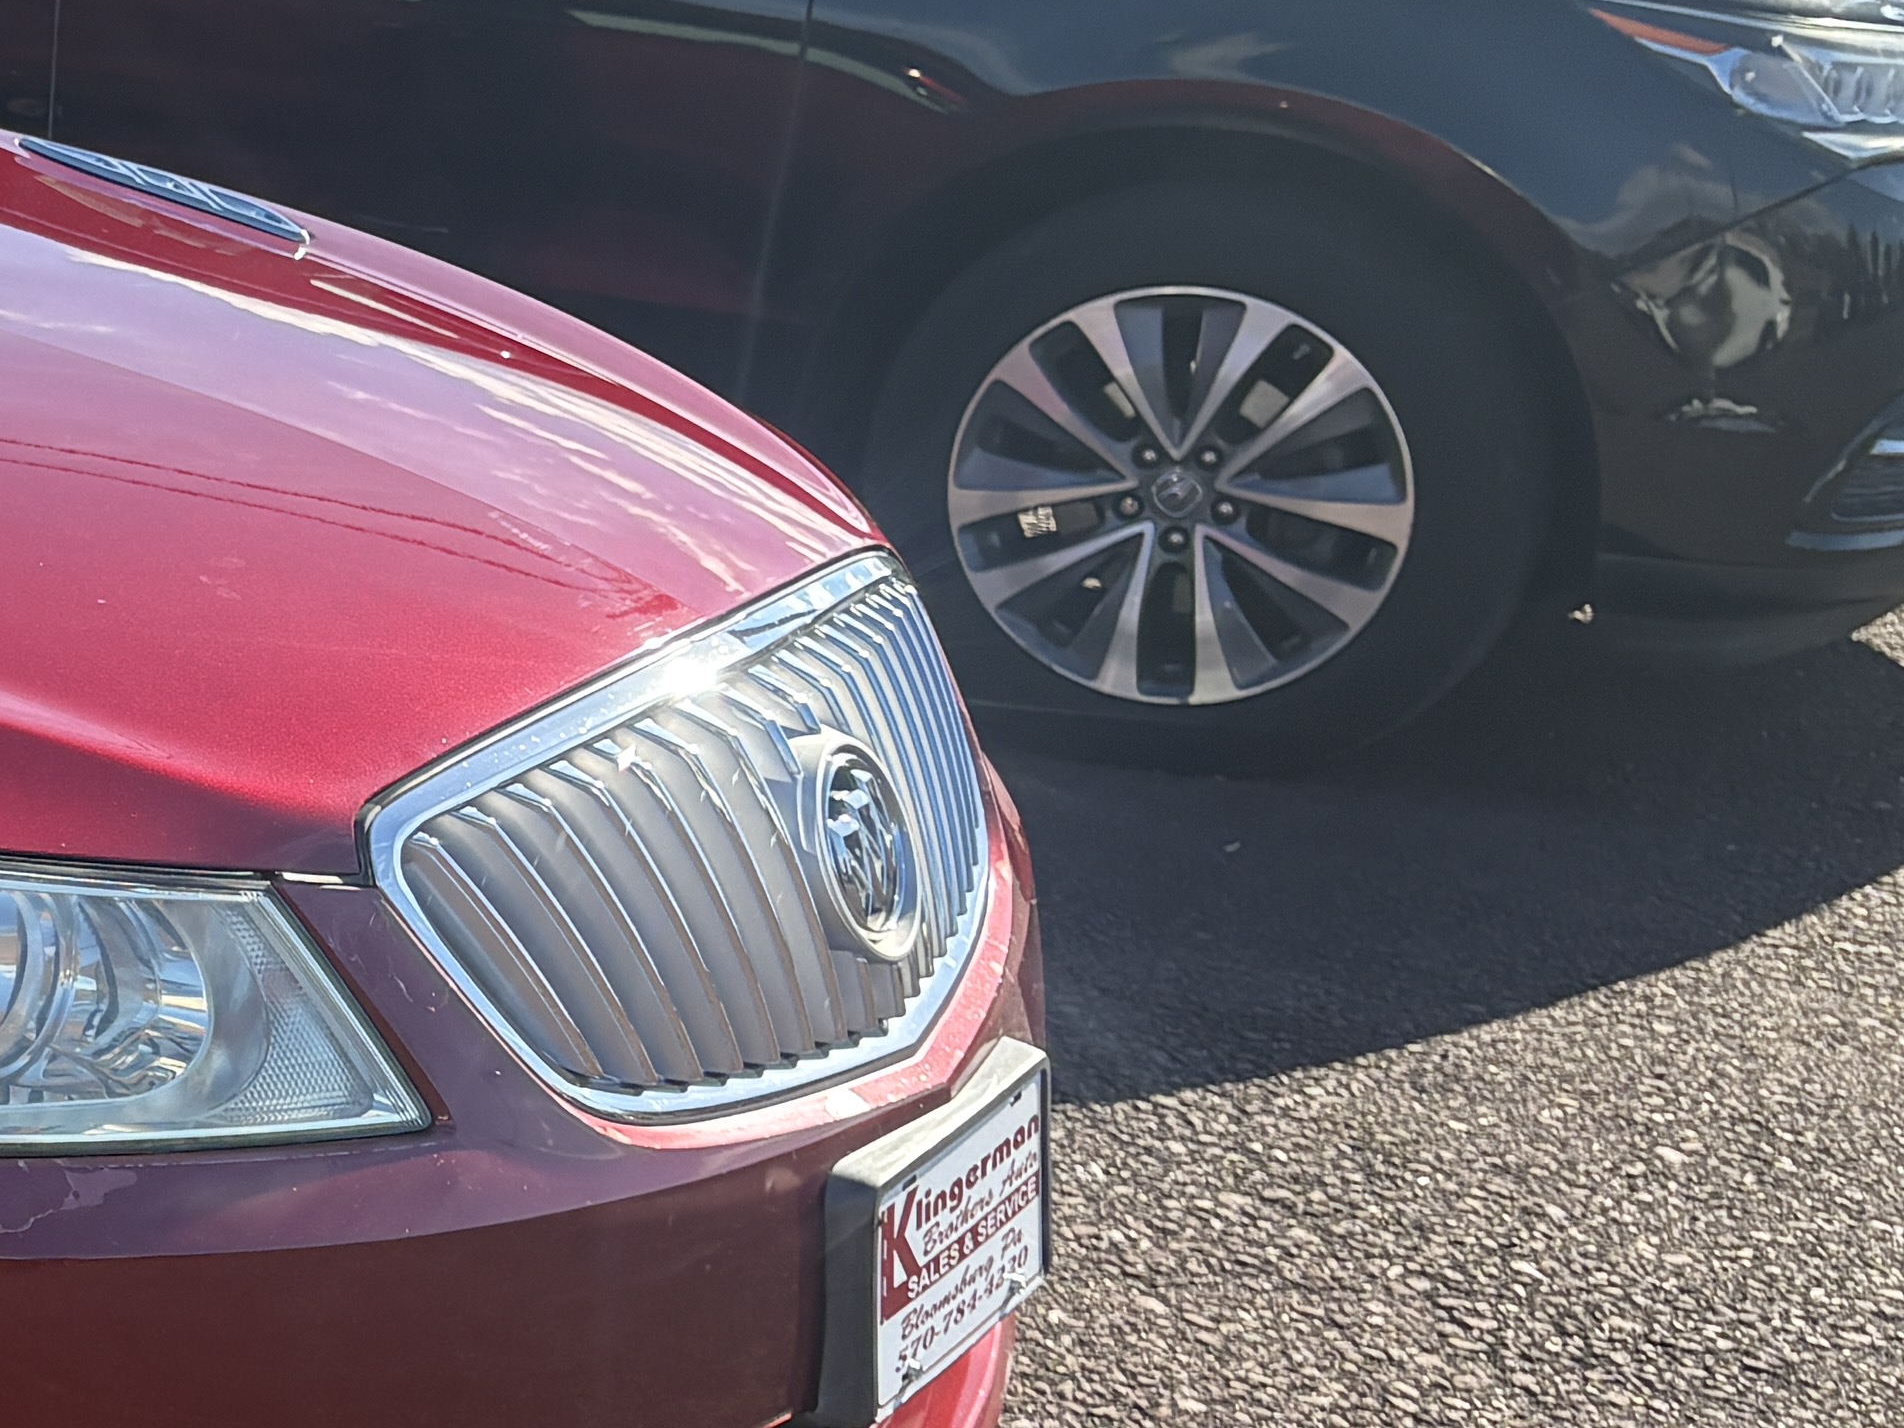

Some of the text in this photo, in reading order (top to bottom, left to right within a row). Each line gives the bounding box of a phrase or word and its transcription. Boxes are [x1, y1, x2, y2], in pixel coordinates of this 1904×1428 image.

[881, 1114, 1040, 1314] Klingerman
[907, 1175, 1038, 1300] SALES & SERVICE
[922, 1151, 1039, 1257] Brothers Auto
[901, 1254, 994, 1341] Bloomsburg
